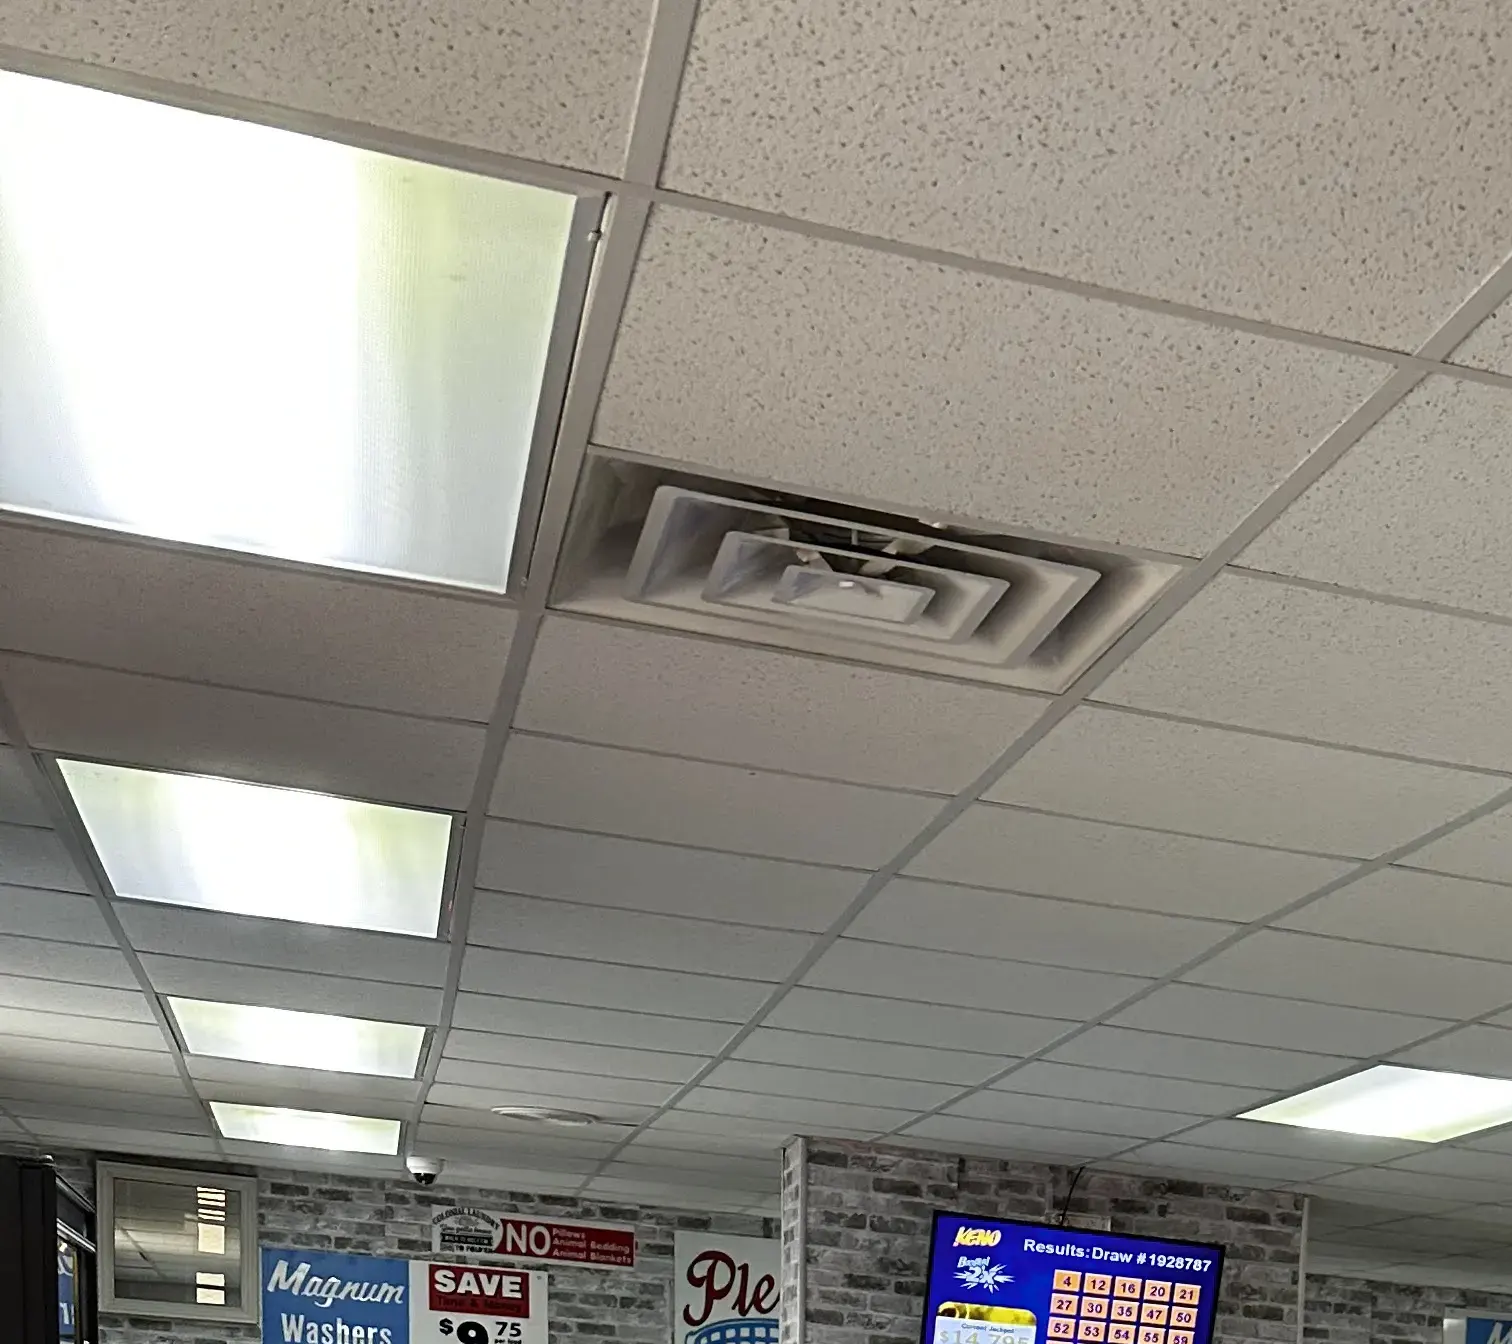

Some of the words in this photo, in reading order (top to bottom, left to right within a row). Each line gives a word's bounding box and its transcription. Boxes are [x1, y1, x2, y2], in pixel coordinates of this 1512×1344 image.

[506, 1223, 551, 1256] NO
[552, 1227, 586, 1240] Pillows
[552, 1237, 587, 1249] Animal
[590, 1240, 630, 1254] Bedding
[952, 1226, 1002, 1247] KENO
[552, 1249, 587, 1260] Animal
[589, 1251, 632, 1264] Blankets
[1023, 1238, 1091, 1259] Results:
[1091, 1247, 1133, 1264] Draw
[267, 1259, 405, 1308] Magnum
[434, 1269, 522, 1299] SAVE
[682, 1250, 780, 1327] Ple
[1063, 1276, 1072, 1288] 4
[1090, 1280, 1107, 1291] 12
[1121, 1283, 1136, 1294] 16
[1150, 1286, 1166, 1298] 20
[1179, 1289, 1194, 1301] 21
[1056, 1299, 1073, 1311] 27
[1087, 1303, 1103, 1314] 30
[1117, 1306, 1133, 1318] 35
[1146, 1309, 1163, 1321] 47
[1176, 1313, 1192, 1324] 50
[495, 1321, 522, 1338] 75
[1053, 1323, 1070, 1335] 52
[1084, 1326, 1100, 1338] 53
[1114, 1329, 1130, 1341] 54
[1144, 1332, 1159, 1344] 55
